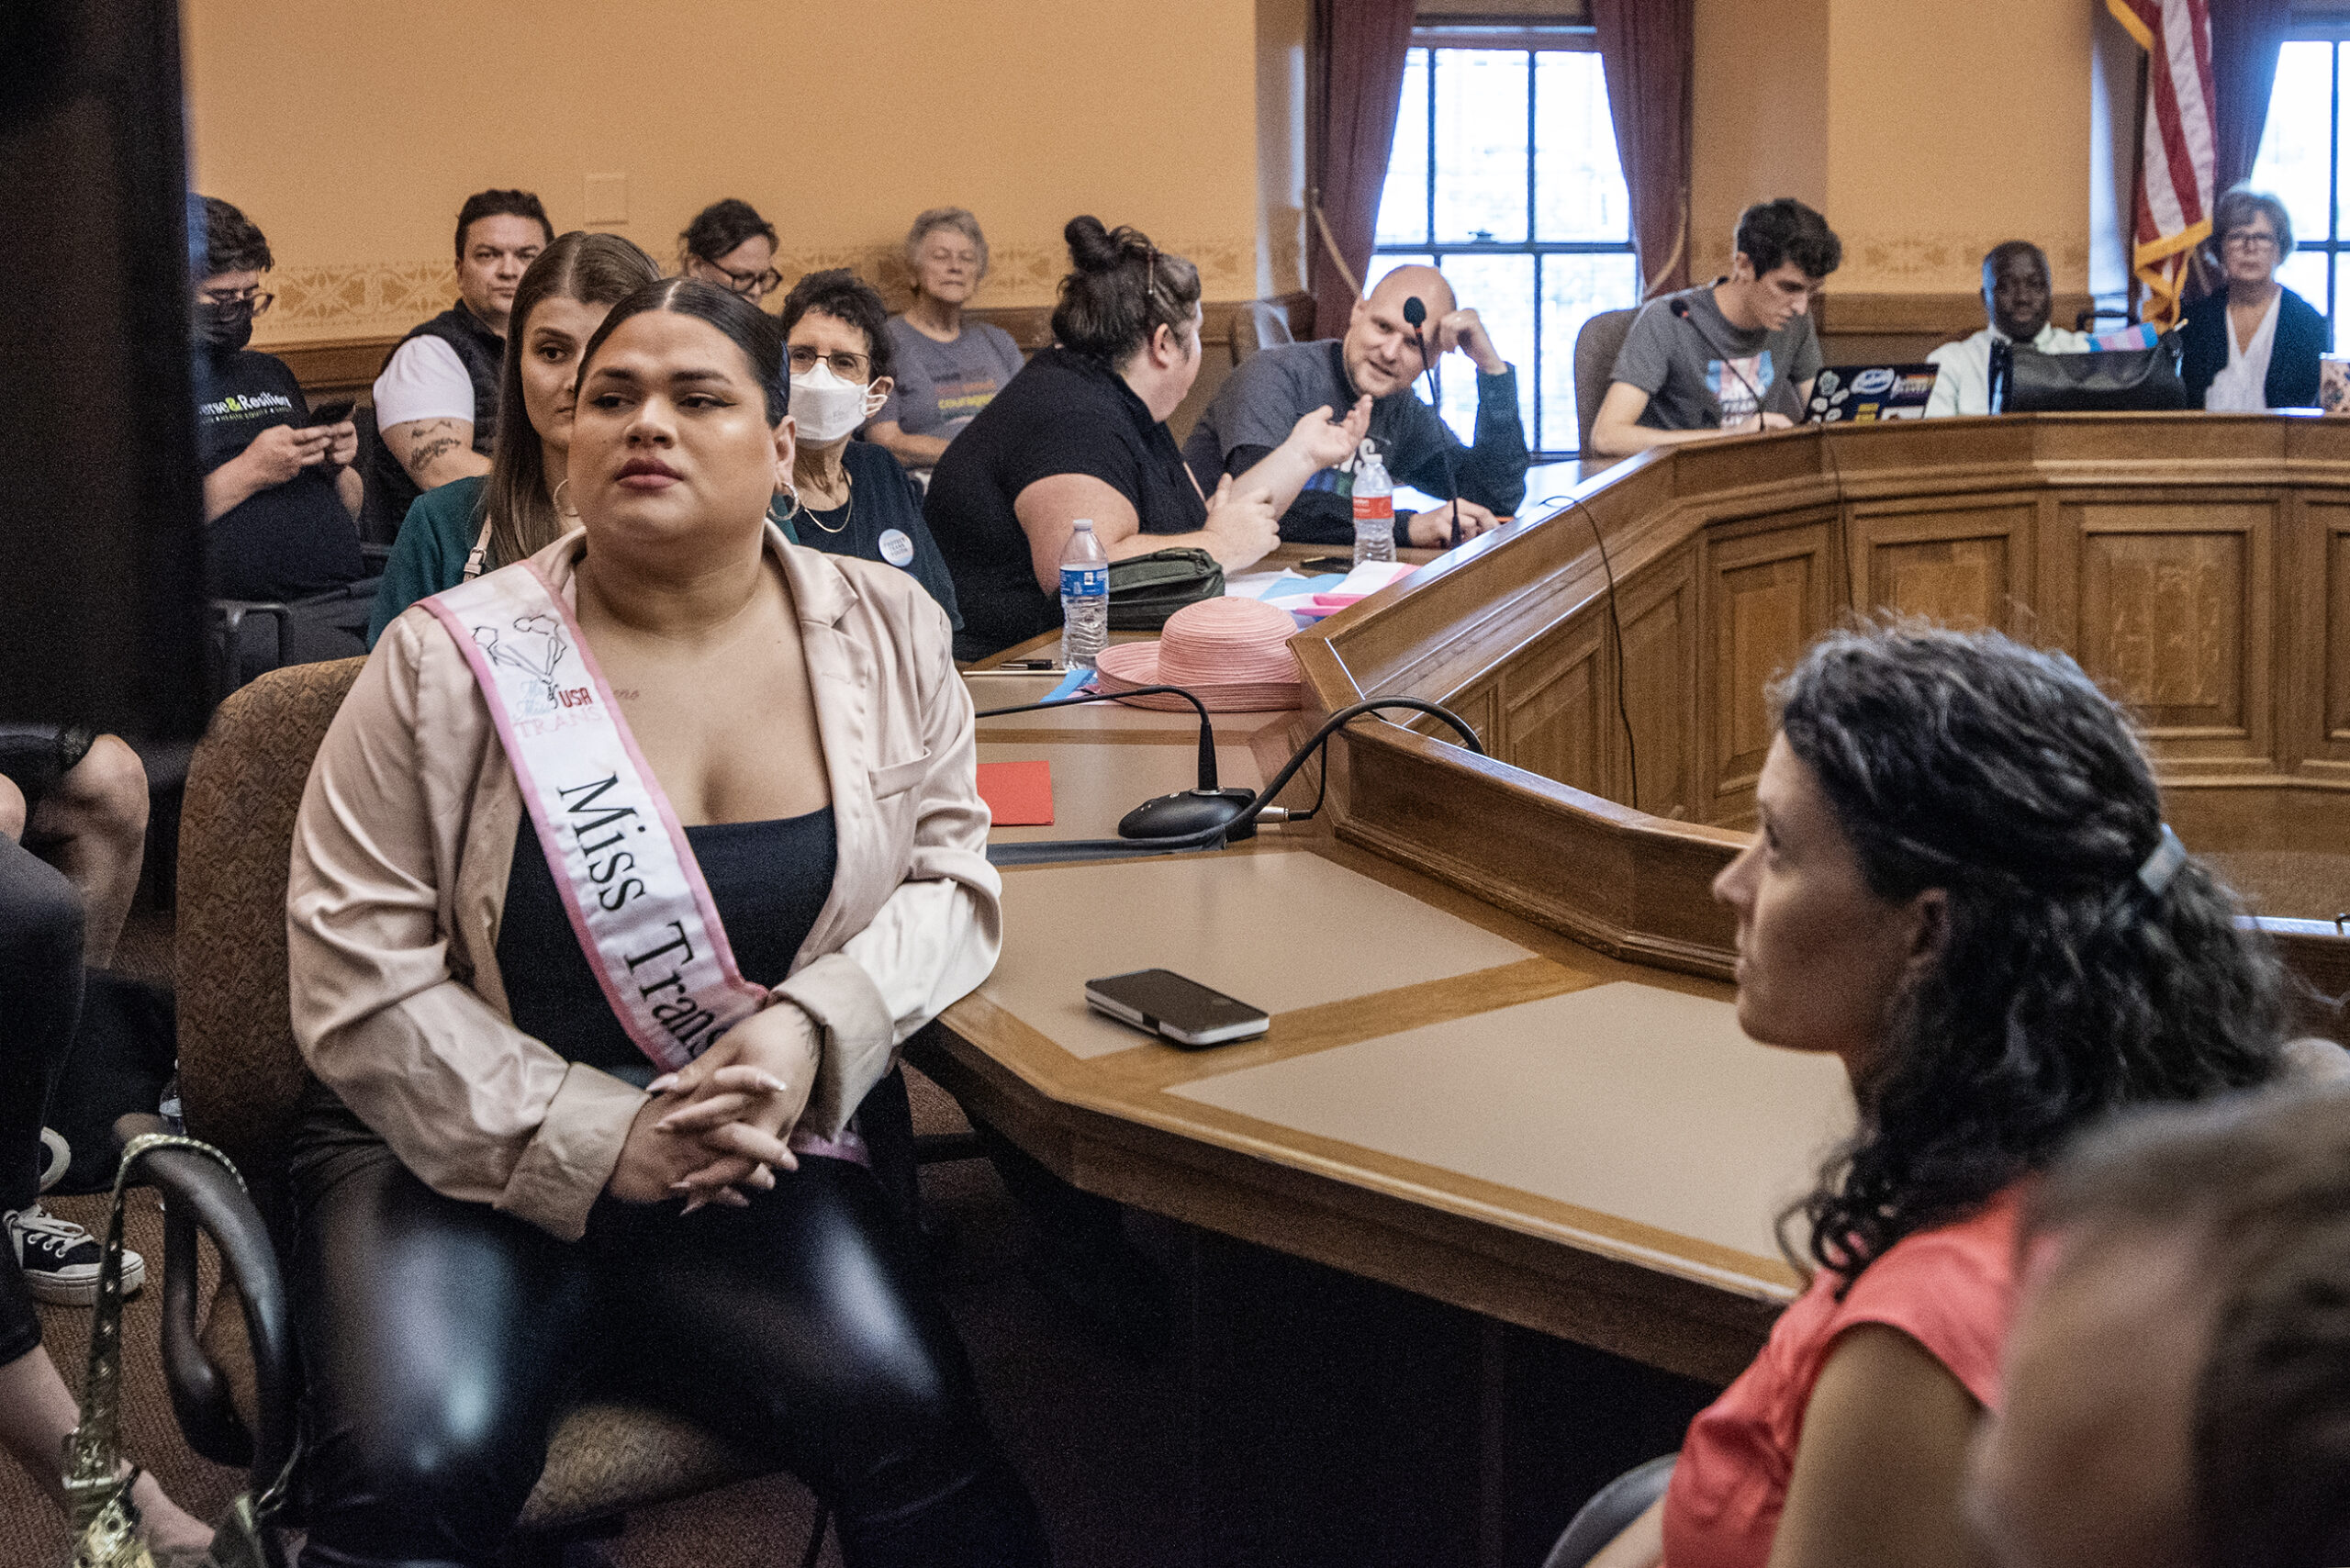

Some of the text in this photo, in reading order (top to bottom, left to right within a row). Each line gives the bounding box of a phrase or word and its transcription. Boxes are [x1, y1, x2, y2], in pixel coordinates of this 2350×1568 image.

[558, 688, 593, 708] USA
[513, 705, 603, 738] TRANS
[555, 770, 646, 913] Miss
